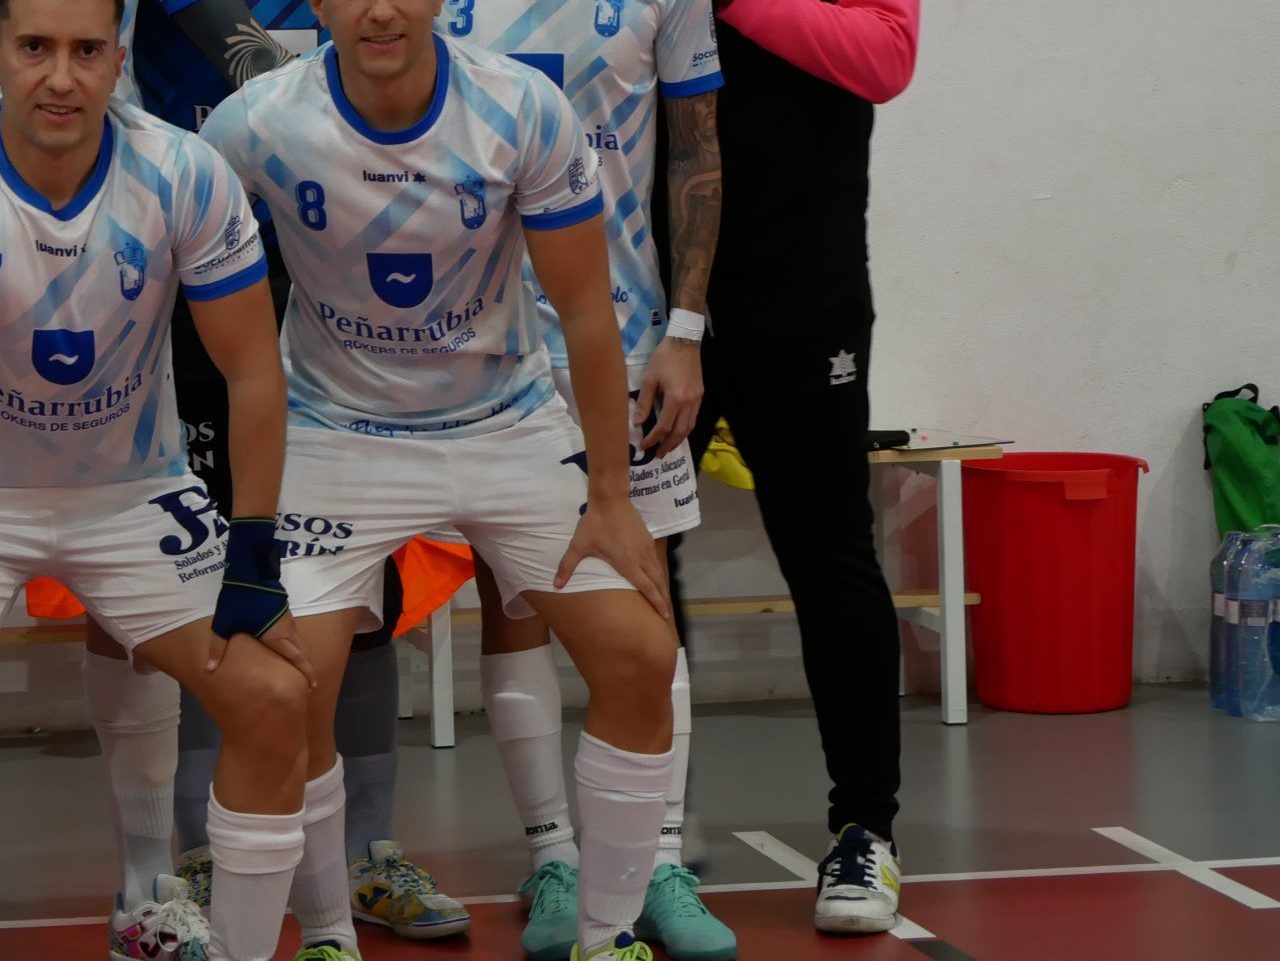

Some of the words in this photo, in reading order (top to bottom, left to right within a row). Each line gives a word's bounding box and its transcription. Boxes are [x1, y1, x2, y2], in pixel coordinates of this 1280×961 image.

[363, 170, 409, 183] luanvi
[295, 180, 327, 231] 8
[35, 239, 78, 258] luanvi
[319, 297, 484, 343] Peñarrubia
[344, 340, 396, 354] ROKERS
[50, 422, 69, 432] DE
[73, 403, 131, 431] SEGUROS
[628, 483, 661, 498] eformas
[661, 480, 672, 490] en
[274, 512, 354, 539] SOS
[174, 548, 215, 571] Solados
[214, 544, 222, 556] y
